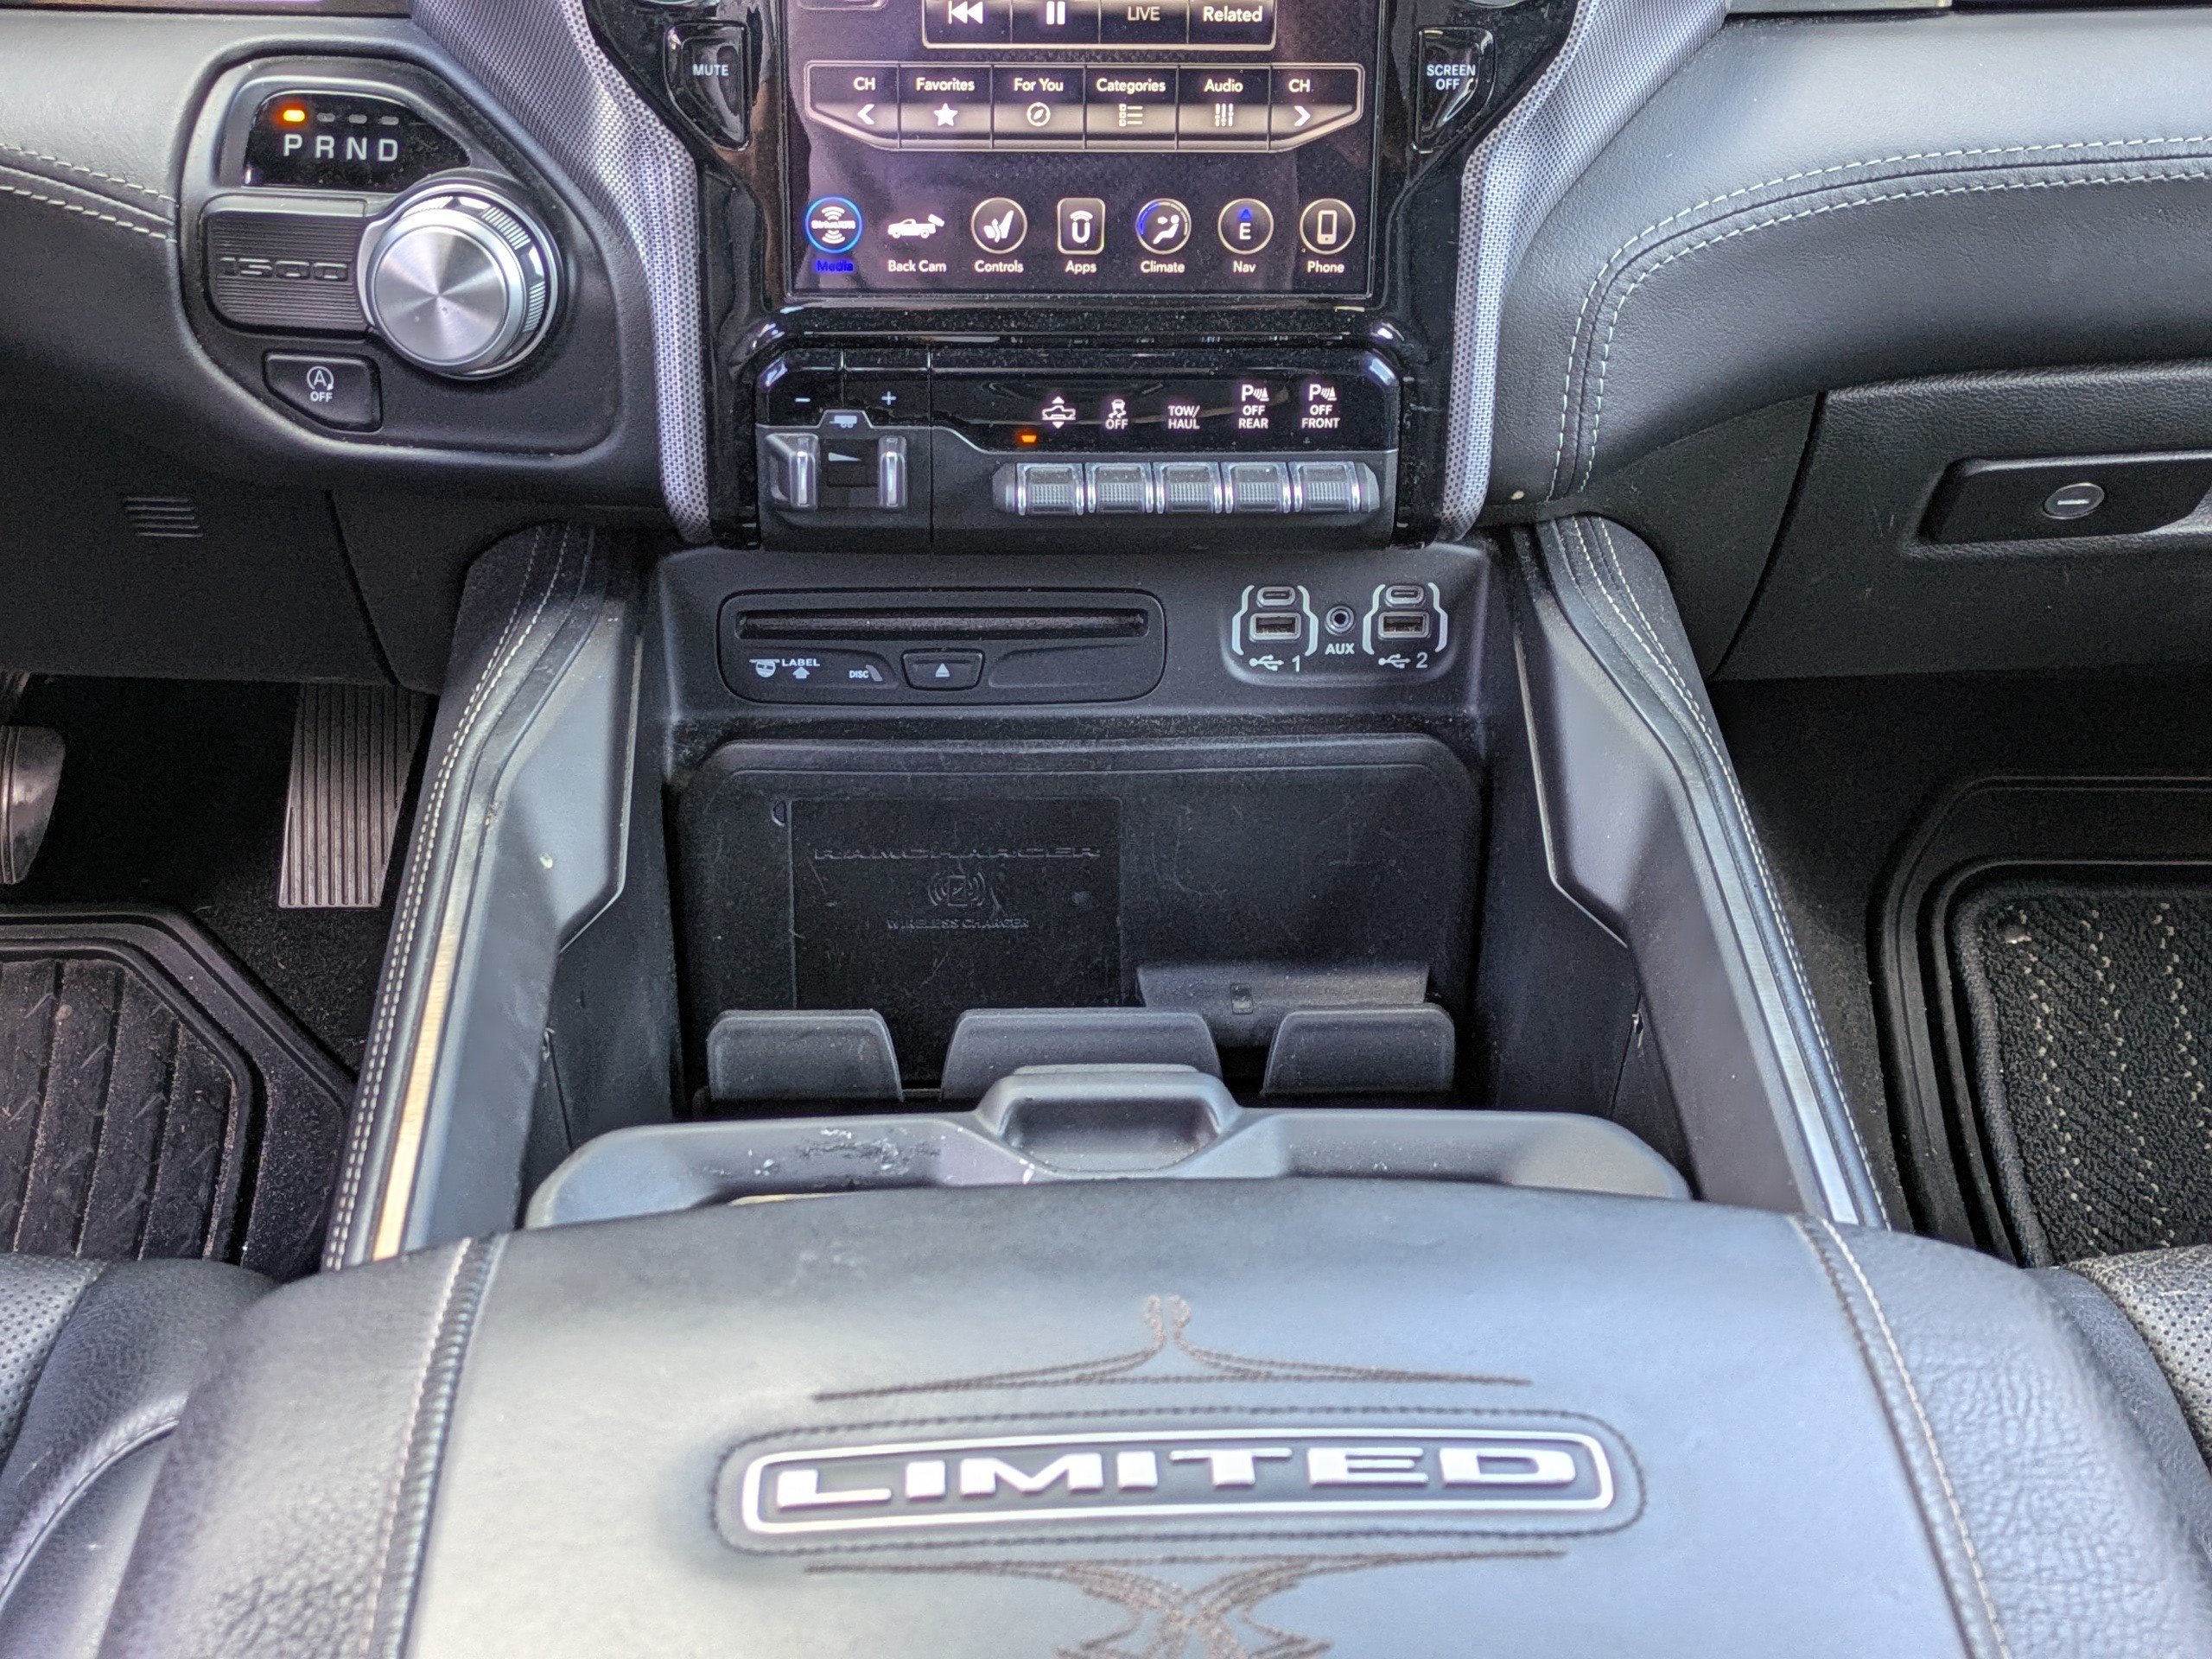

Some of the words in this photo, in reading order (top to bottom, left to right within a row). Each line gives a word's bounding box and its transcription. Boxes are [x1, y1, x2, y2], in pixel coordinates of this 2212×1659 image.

[1127, 6, 1160, 22] LIVE
[1203, 5, 1263, 23] Related
[692, 63, 729, 76] MUTE
[1426, 64, 1476, 76] SCREEN
[853, 77, 876, 91] CH
[916, 77, 976, 92] Favorites
[1014, 78, 1037, 92] For
[1039, 78, 1064, 92] You
[1096, 78, 1166, 95] Categories
[1205, 79, 1243, 92] Audio
[1288, 79, 1311, 92] CH
[1435, 79, 1460, 91] OFF
[817, 261, 854, 272] Media
[887, 260, 916, 272] Back
[918, 260, 947, 272] Cam
[974, 260, 1024, 273] Controls
[1065, 261, 1096, 276] Apps
[1141, 260, 1185, 274] Climate
[1233, 261, 1255, 274] Nav
[1307, 261, 1344, 274] Phone
[310, 391, 333, 402] OFF
[1167, 405, 1200, 418] TOW/
[1242, 405, 1266, 416] OFF
[1309, 404, 1333, 416] OFF
[1105, 418, 1128, 429] OFF
[1167, 418, 1200, 429] HAUL
[1238, 418, 1268, 429] REAR
[1301, 417, 1340, 429] FRONT
[1325, 643, 1355, 655] AUX
[781, 658, 821, 667] LABEL
[1292, 655, 1300, 671] 1
[1415, 652, 1428, 668] 2
[849, 670, 869, 679] DISC
[775, 1446, 1578, 1510] LIMITED
